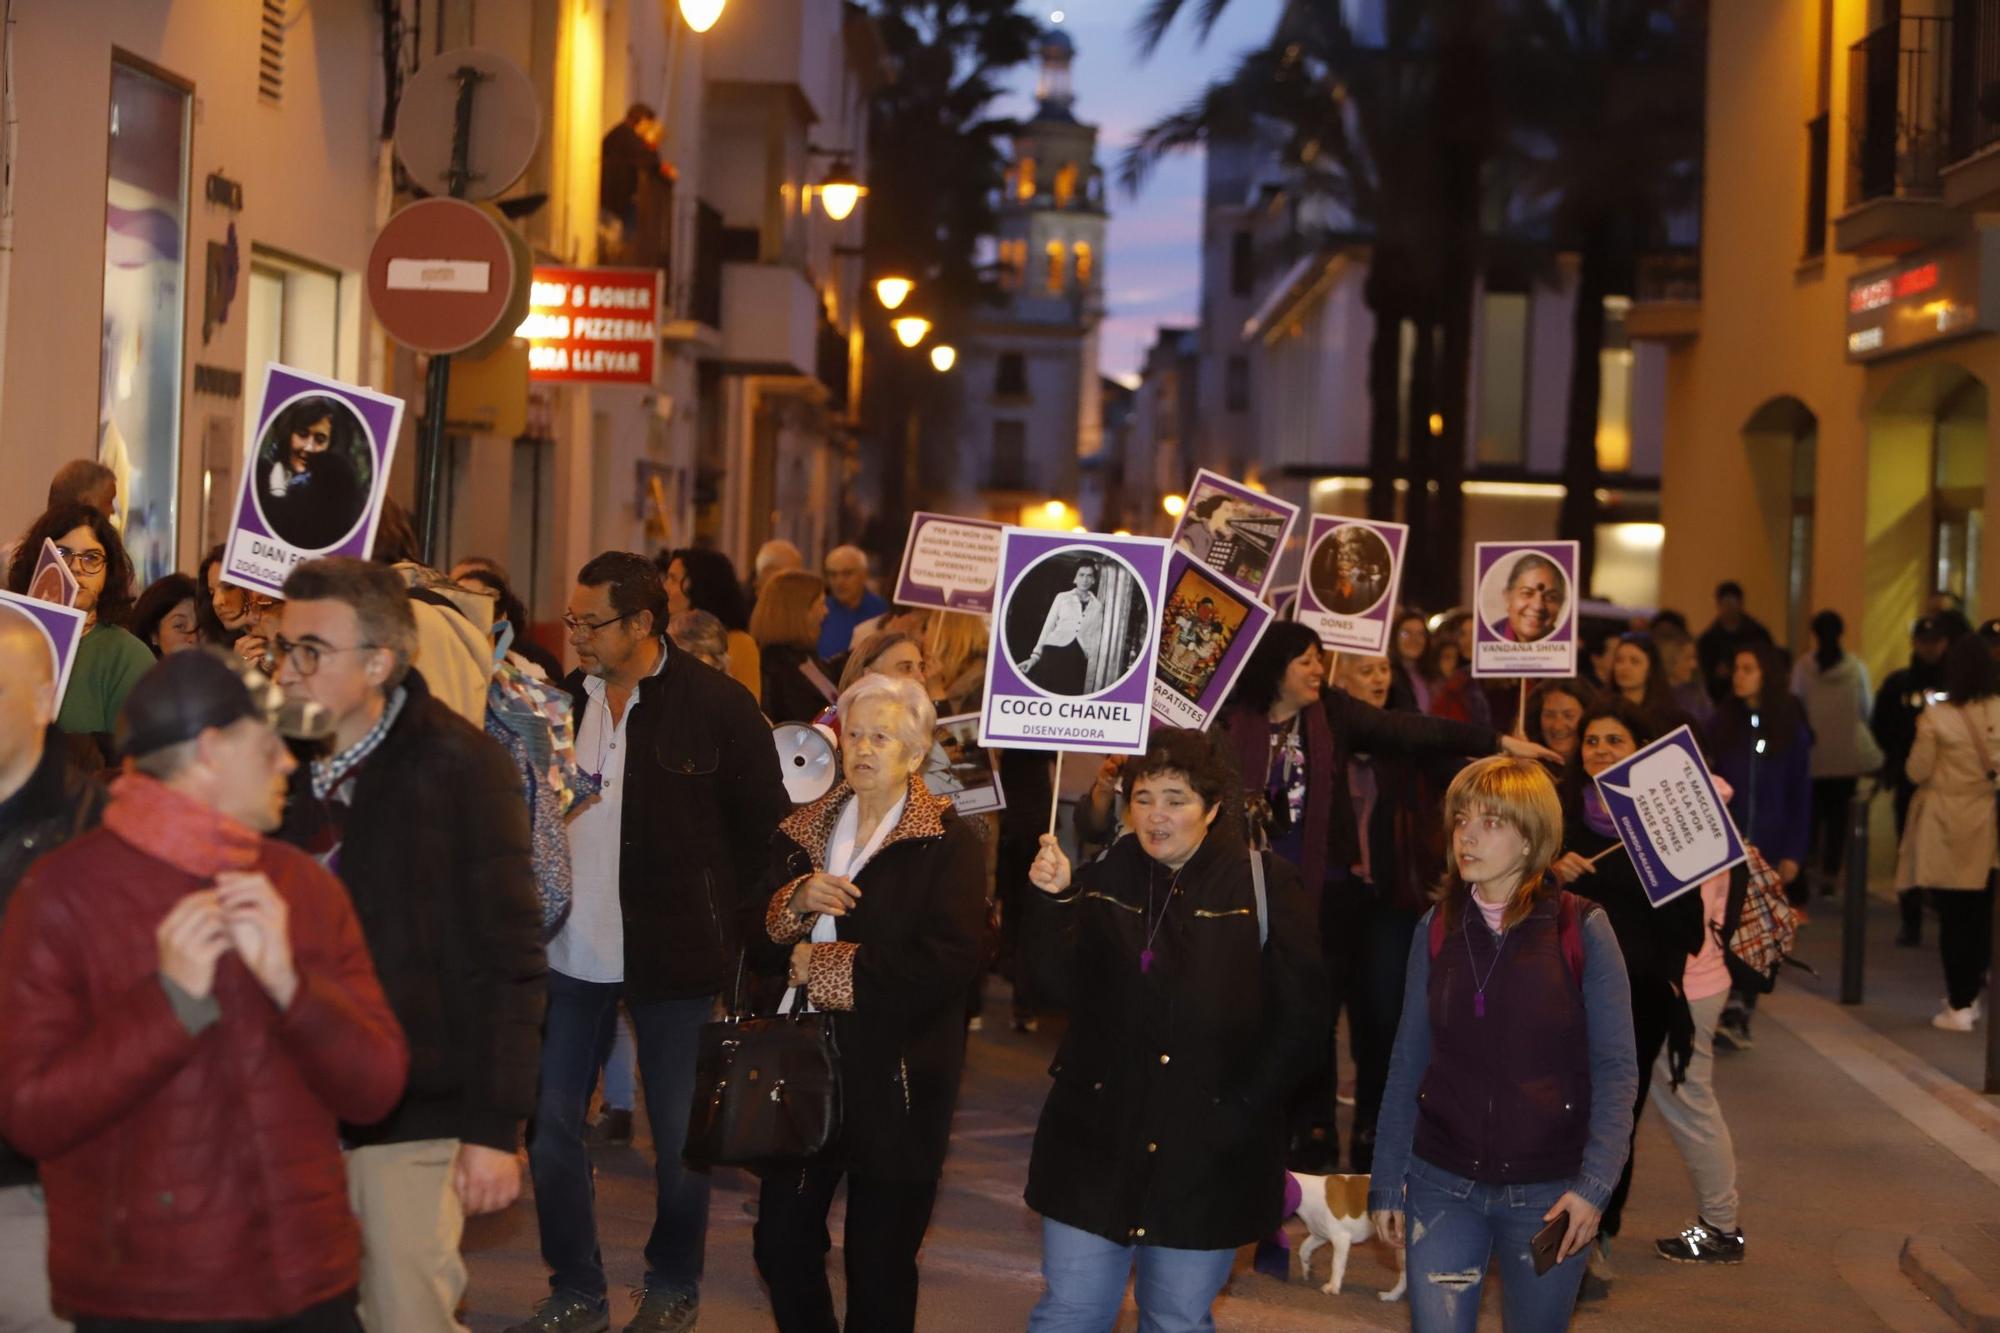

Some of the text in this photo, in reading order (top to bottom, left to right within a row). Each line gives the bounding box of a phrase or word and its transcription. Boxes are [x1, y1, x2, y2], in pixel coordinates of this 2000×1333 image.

[588, 286, 649, 309] DONER
[573, 317, 655, 341] PIZZERIA
[572, 349, 640, 374] LLEVAR
[252, 541, 286, 564] DIAN
[1320, 618, 1354, 630] DONES
[1481, 643, 1566, 652] VANDANA SHIVA
[1000, 699, 1131, 722] COCO CHANEL
[1153, 681, 1204, 722] APATISTES
[1153, 700, 1171, 715] UITA
[1022, 725, 1105, 739] DISENYADORA
[1636, 794, 1657, 828] SENSE
[1648, 787, 1684, 853] A LES DONES
[1659, 779, 1694, 844] DELS HOMES
[1682, 794, 1693, 809] LA
[1689, 809, 1704, 832] POR
[1690, 779, 1722, 840] MASCLISME
[1621, 816, 1658, 887] EDUARDO GALEANO
